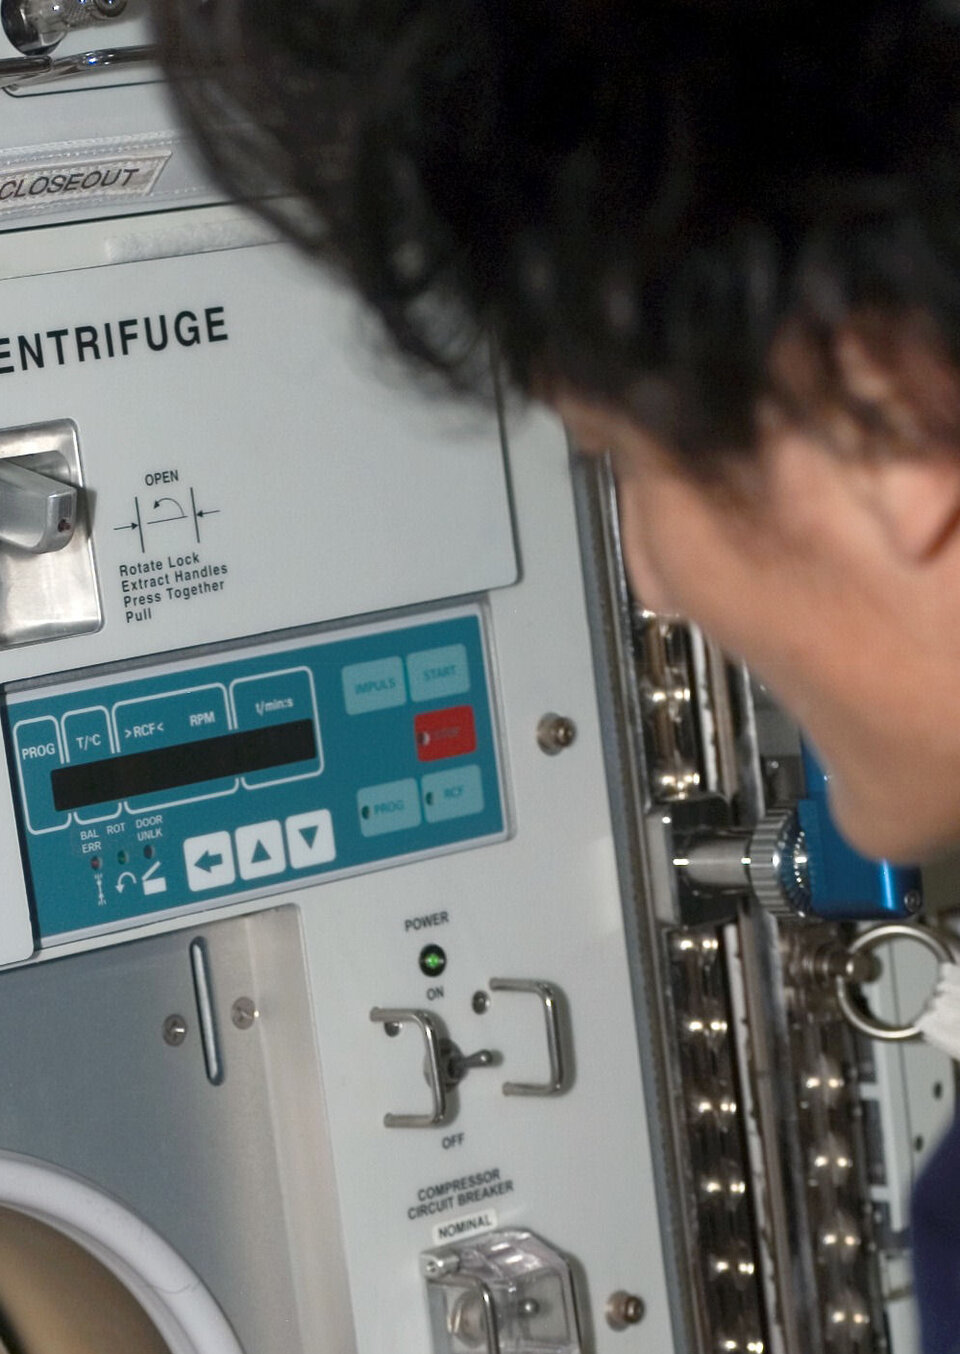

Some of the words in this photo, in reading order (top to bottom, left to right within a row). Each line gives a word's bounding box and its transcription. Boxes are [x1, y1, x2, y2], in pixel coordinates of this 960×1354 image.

[145, 470, 179, 486] OPEN
[119, 560, 163, 577] Rotate
[168, 552, 200, 568] Lock
[121, 574, 170, 592] Extract
[174, 564, 228, 582] Handles
[123, 592, 161, 608] Press
[166, 580, 225, 600] Together
[126, 608, 152, 623] Pull
[423, 665, 457, 682] START
[354, 678, 396, 695] IMPULS
[189, 711, 216, 727] RPM
[21, 743, 55, 760] PROG
[106, 822, 126, 835] ROT
[135, 815, 163, 829] DOOR
[80, 829, 99, 841] BAL
[137, 828, 163, 841] UNLK
[82, 841, 102, 854] ERR
[404, 911, 450, 933] POWER
[426, 986, 444, 1001] ON
[442, 1133, 466, 1150] OFF
[417, 1168, 501, 1202] COMPRESSOR
[407, 1196, 454, 1221] CIRCUIT
[458, 1180, 514, 1207] BREAKER
[438, 1214, 493, 1240] NOMINAL
